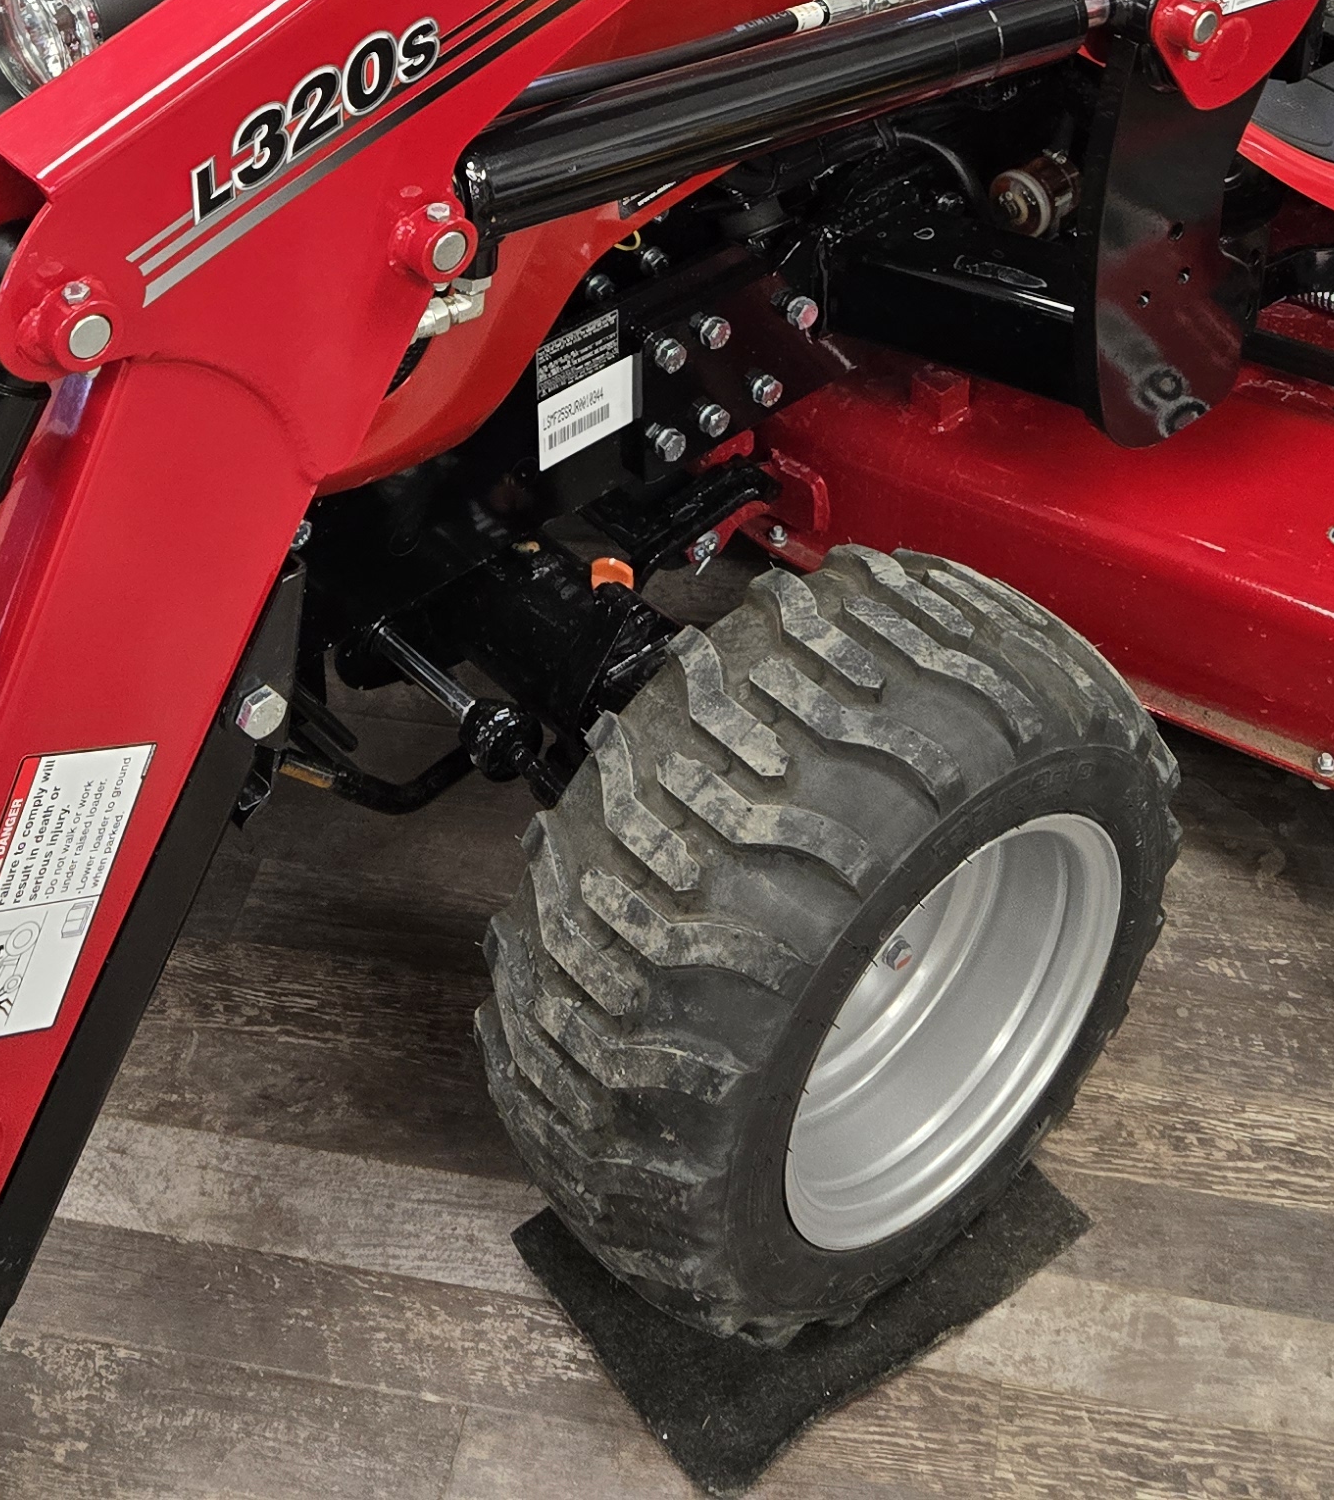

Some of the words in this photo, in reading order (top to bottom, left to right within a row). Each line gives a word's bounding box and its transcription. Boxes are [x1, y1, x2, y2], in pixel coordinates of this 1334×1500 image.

[37, 758, 56, 783] will
[108, 756, 134, 798] ground
[47, 784, 62, 801] or
[74, 779, 95, 809] work
[102, 801, 116, 813] to
[18, 786, 49, 838] comply
[32, 804, 56, 843] death
[70, 811, 83, 824] or
[57, 858, 80, 893] under
[70, 820, 93, 856] raised
[84, 777, 108, 818] loader.
[58, 826, 78, 854] walk
[88, 814, 111, 852] loader
[11, 841, 27, 856] to
[25, 849, 54, 902] serious
[45, 803, 73, 847] injury.
[25, 846, 40, 860] in
[88, 856, 109, 888] when
[101, 810, 126, 855] parked.
[51, 855, 67, 876] not
[9, 862, 35, 904] result
